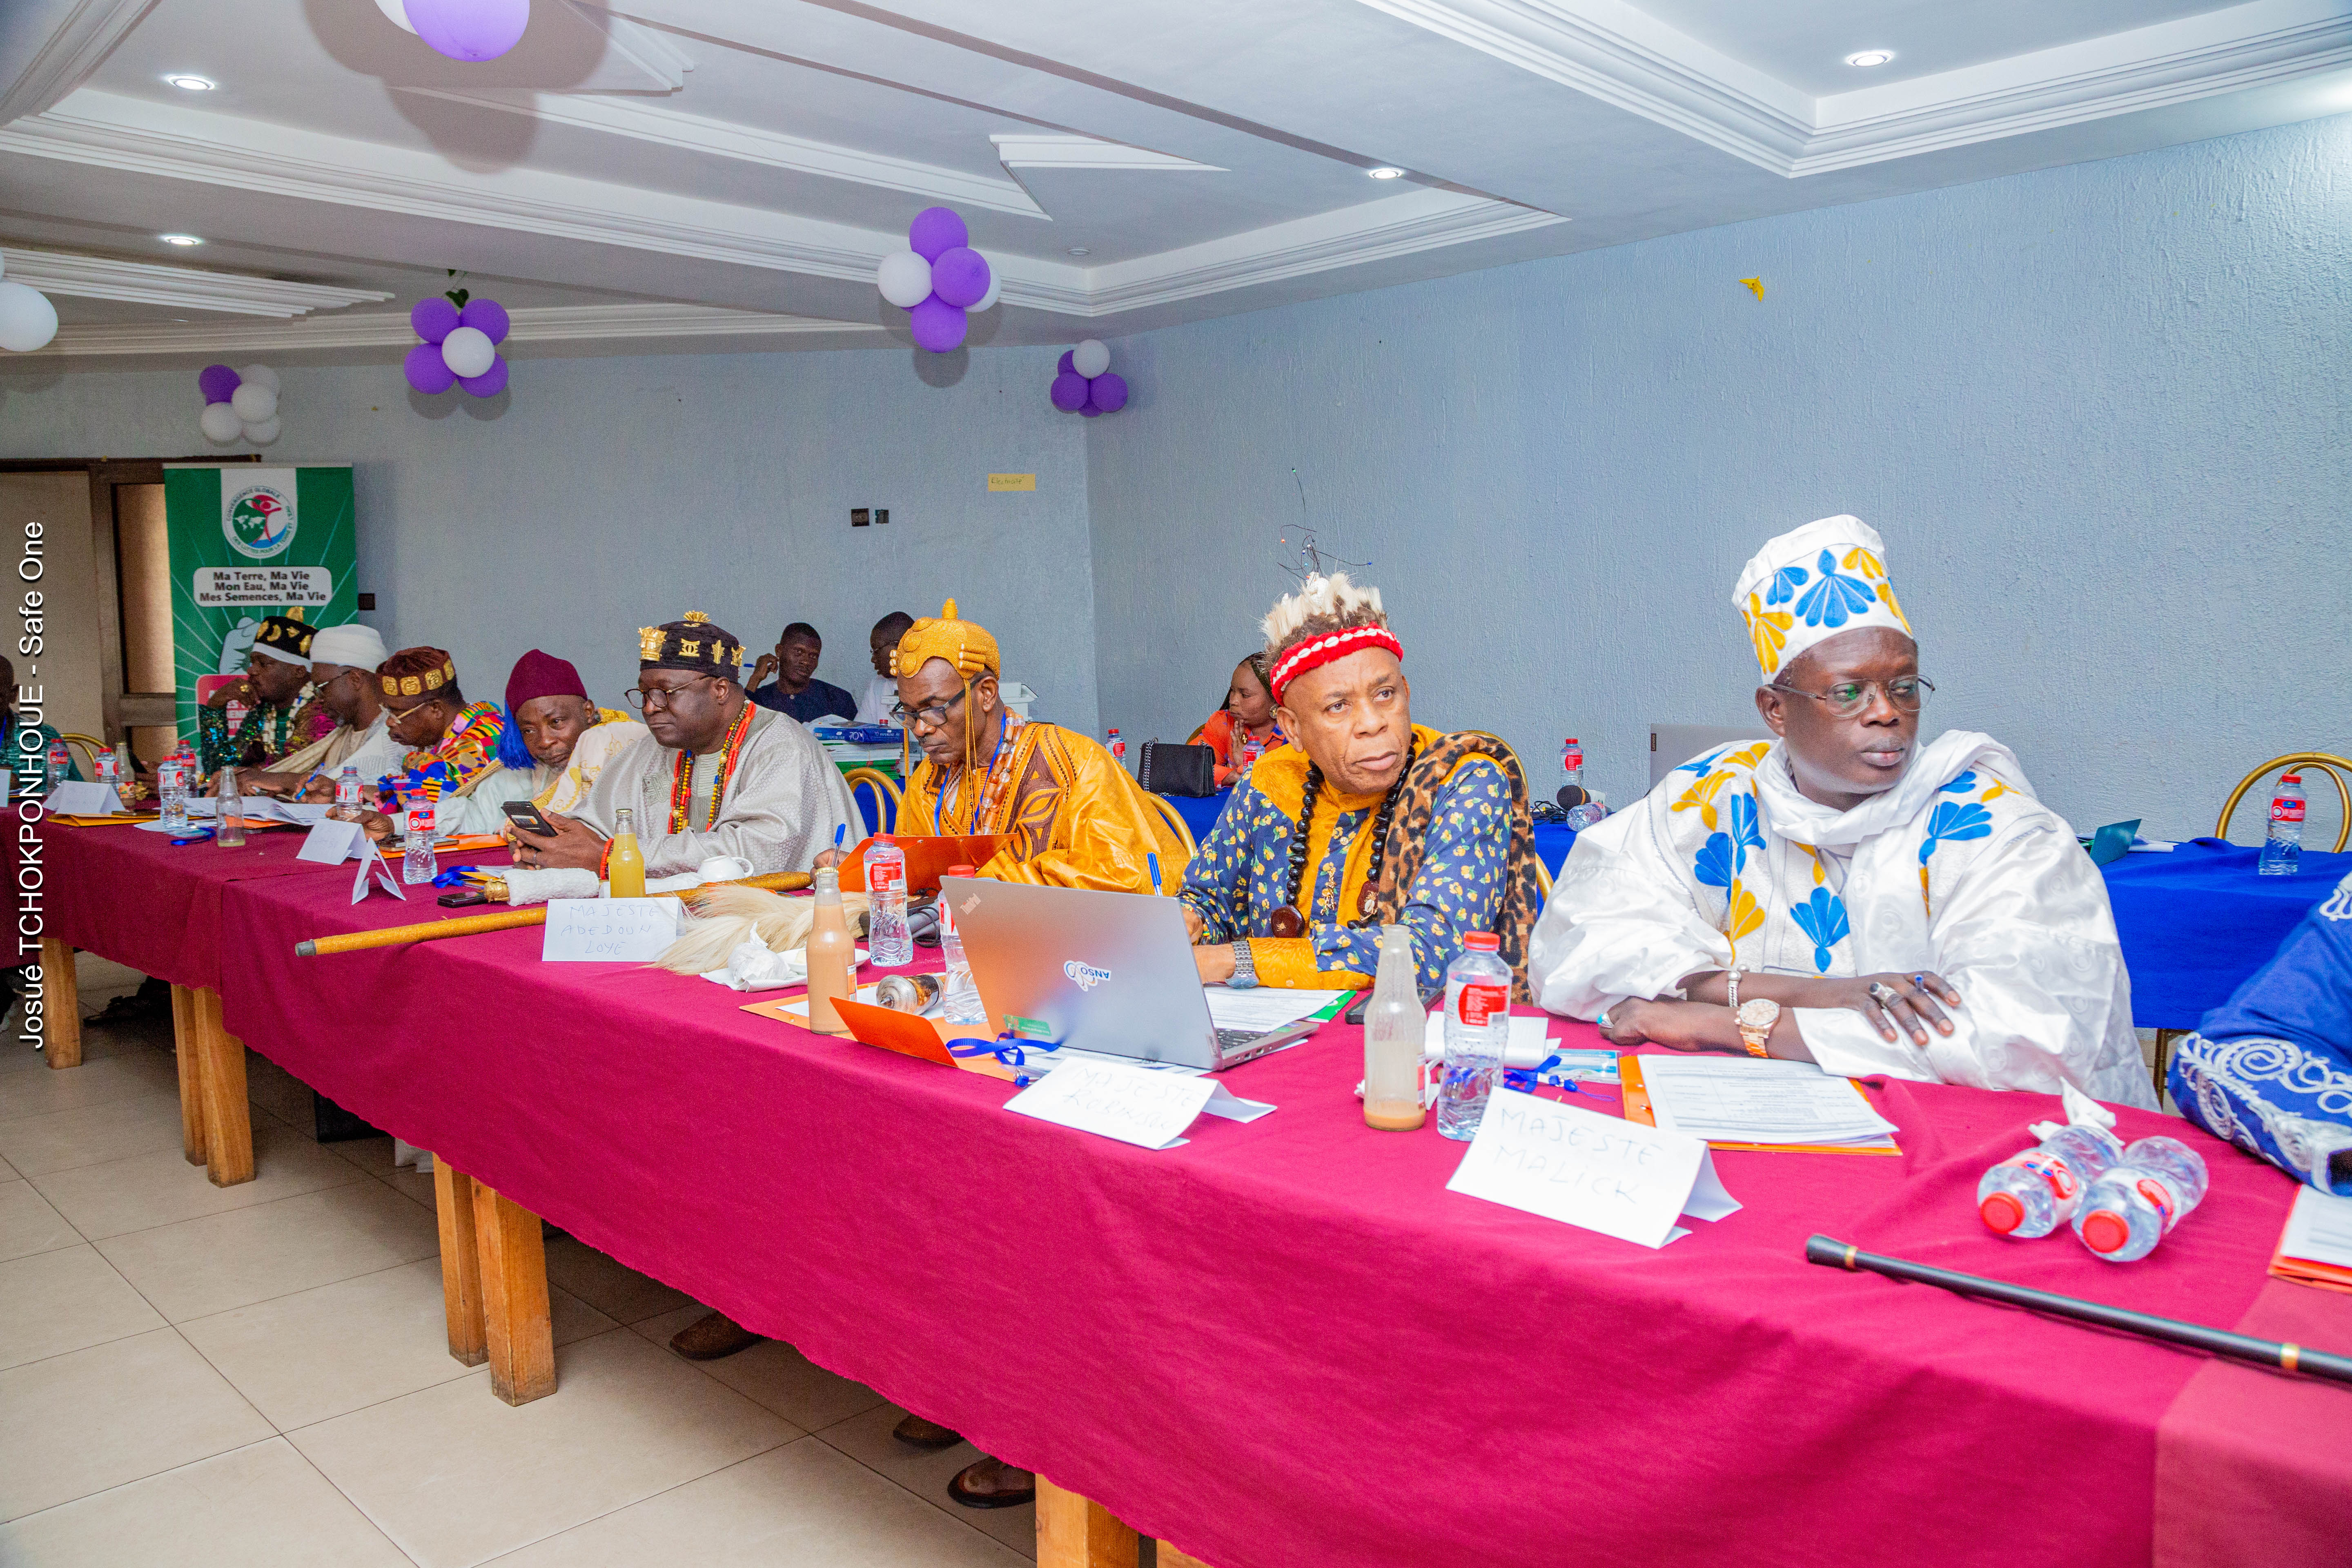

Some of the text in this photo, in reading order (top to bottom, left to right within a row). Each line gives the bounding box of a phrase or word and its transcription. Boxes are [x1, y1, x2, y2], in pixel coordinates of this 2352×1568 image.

[214, 571, 310, 581] Ma Terre, Ma Vie
[215, 581, 309, 591] Mon Eau, Ma Vie
[200, 592, 326, 602] Mes Semences, Ma Vie
[570, 904, 661, 919] MAJESTE
[1080, 967, 1109, 979] ANSO
